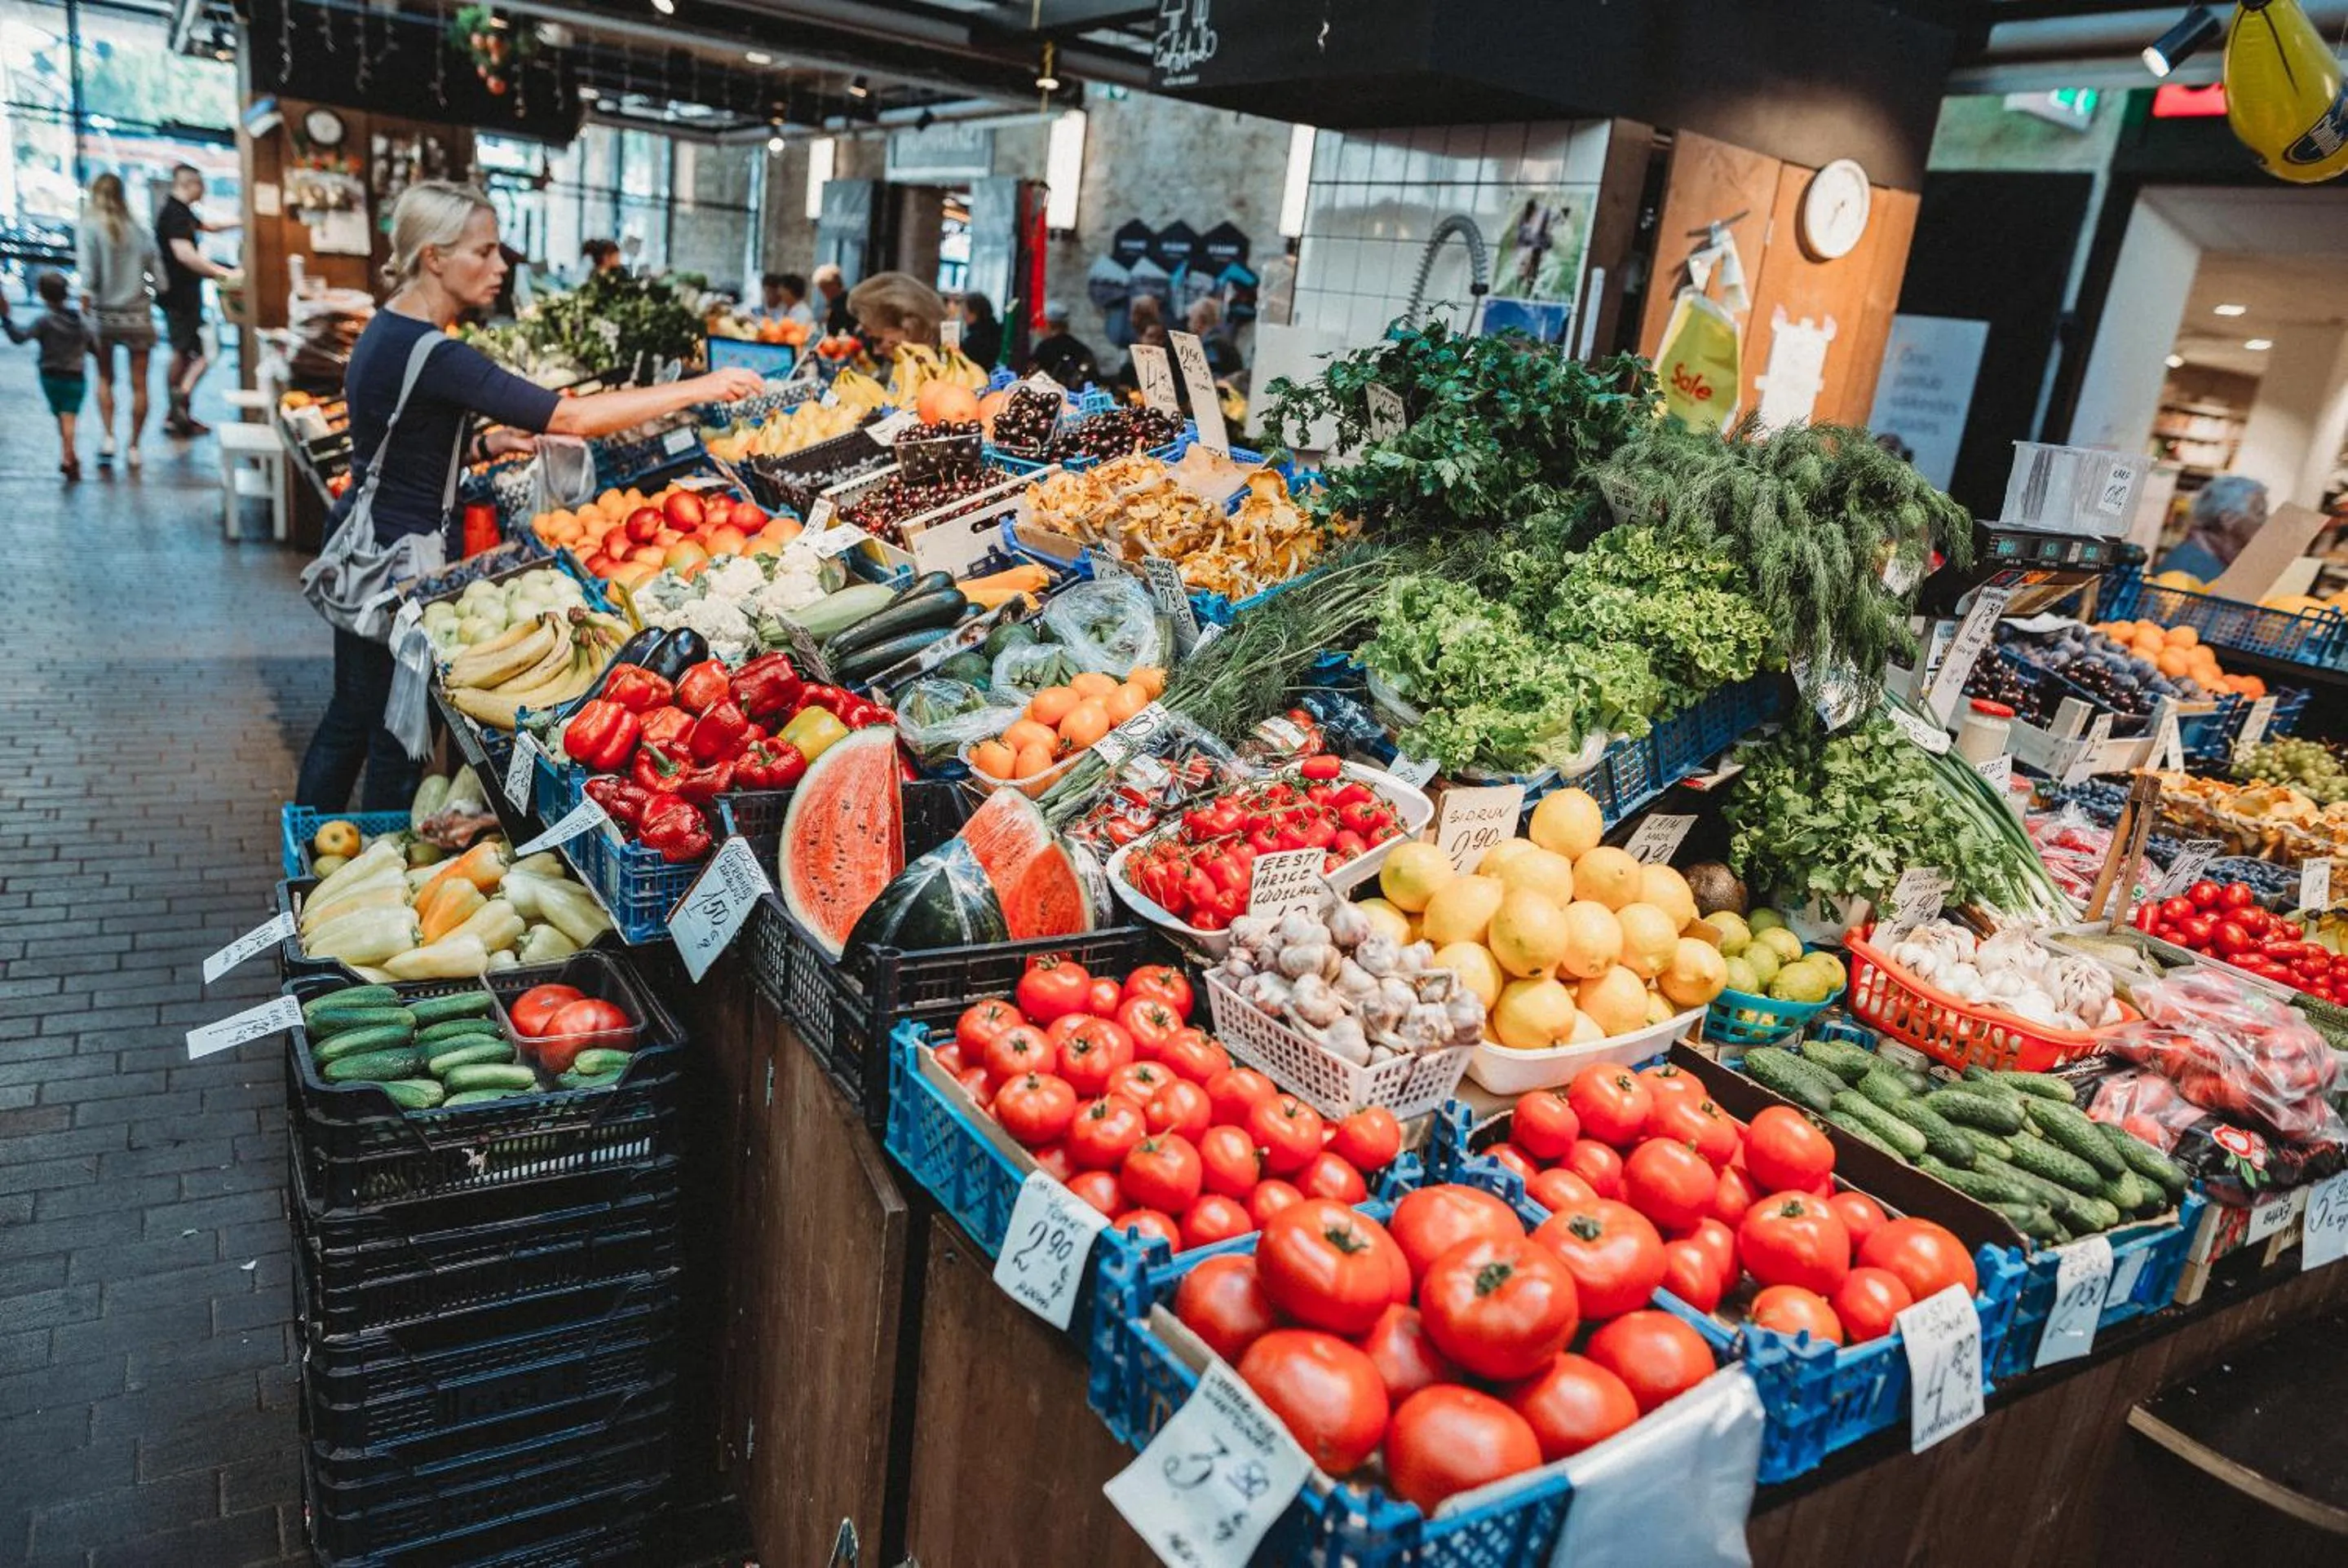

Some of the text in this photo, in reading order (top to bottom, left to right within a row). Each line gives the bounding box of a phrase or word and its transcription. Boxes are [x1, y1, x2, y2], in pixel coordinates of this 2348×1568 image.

[1670, 361, 1713, 402] Sale
[1449, 803, 1512, 824] SIDRUN
[1259, 852, 1320, 872] EESTI
